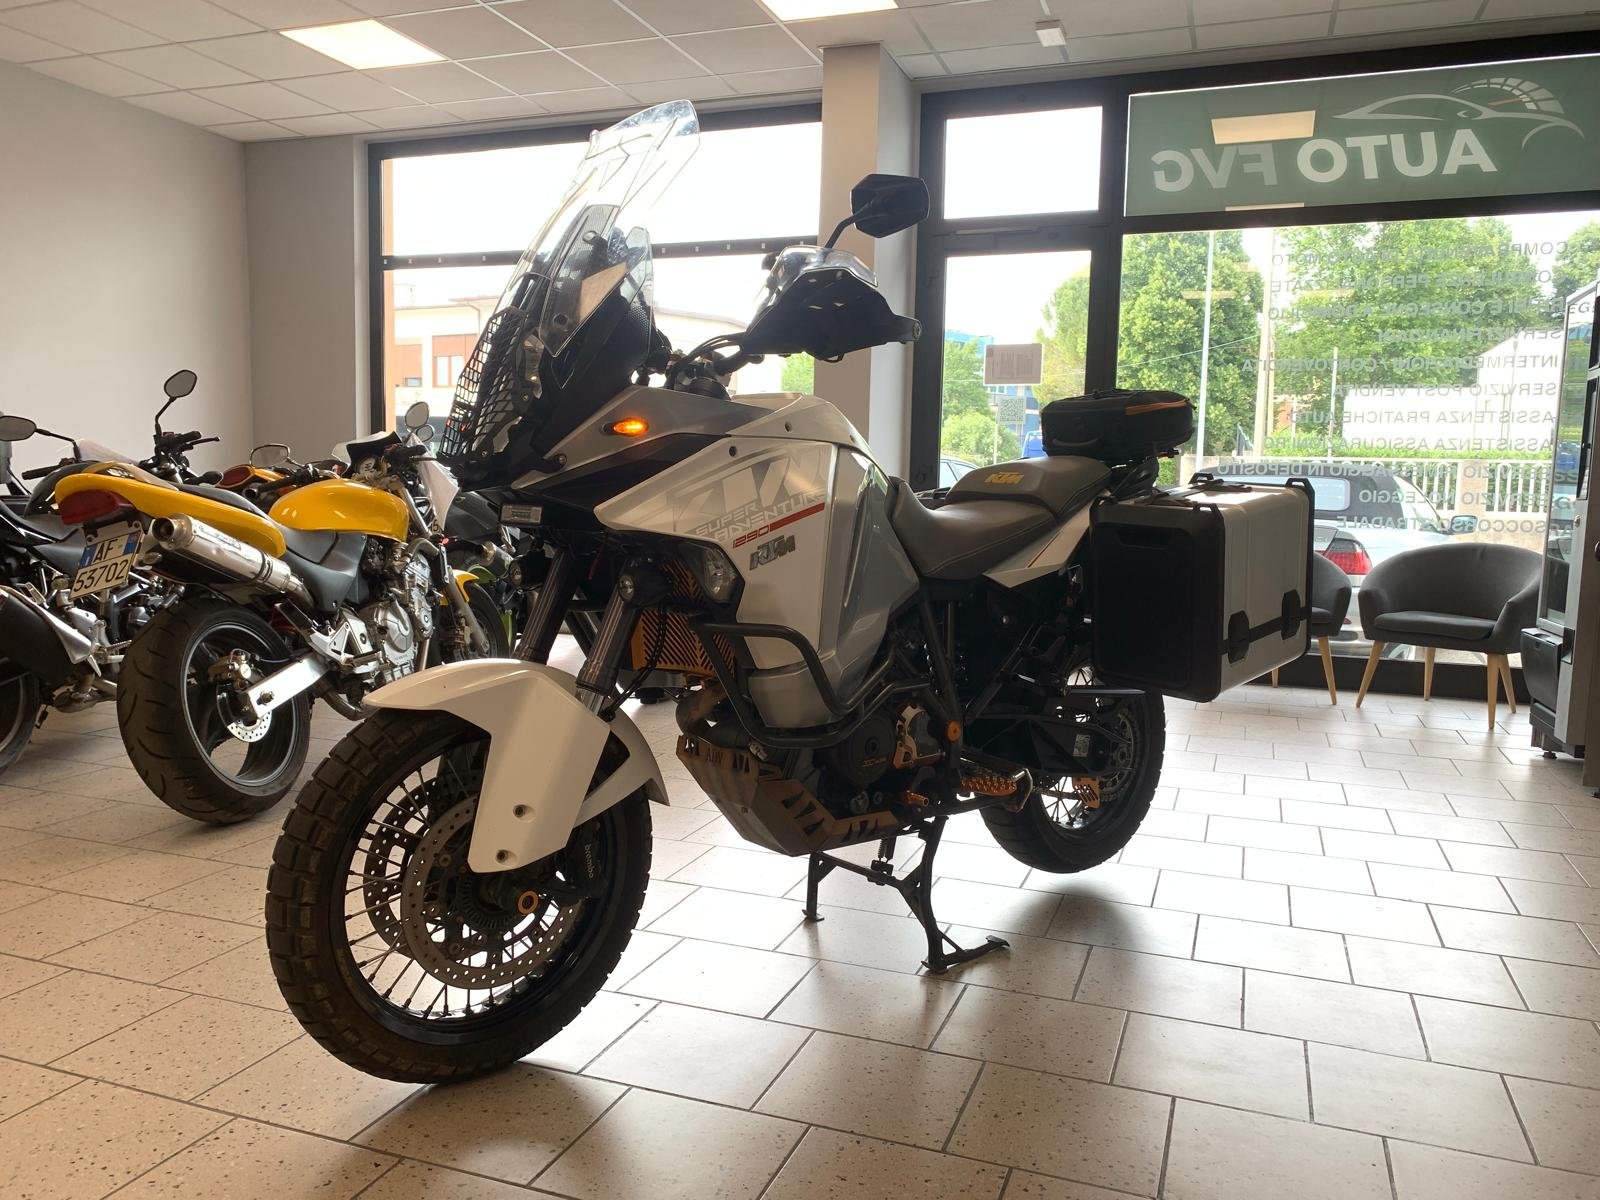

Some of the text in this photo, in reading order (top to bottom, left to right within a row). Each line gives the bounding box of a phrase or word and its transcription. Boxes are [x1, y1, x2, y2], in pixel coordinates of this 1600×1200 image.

[695, 500, 759, 538] SUPER
[93, 538, 118, 563] AF
[749, 534, 796, 571] KTM
[73, 560, 129, 592] 53702
